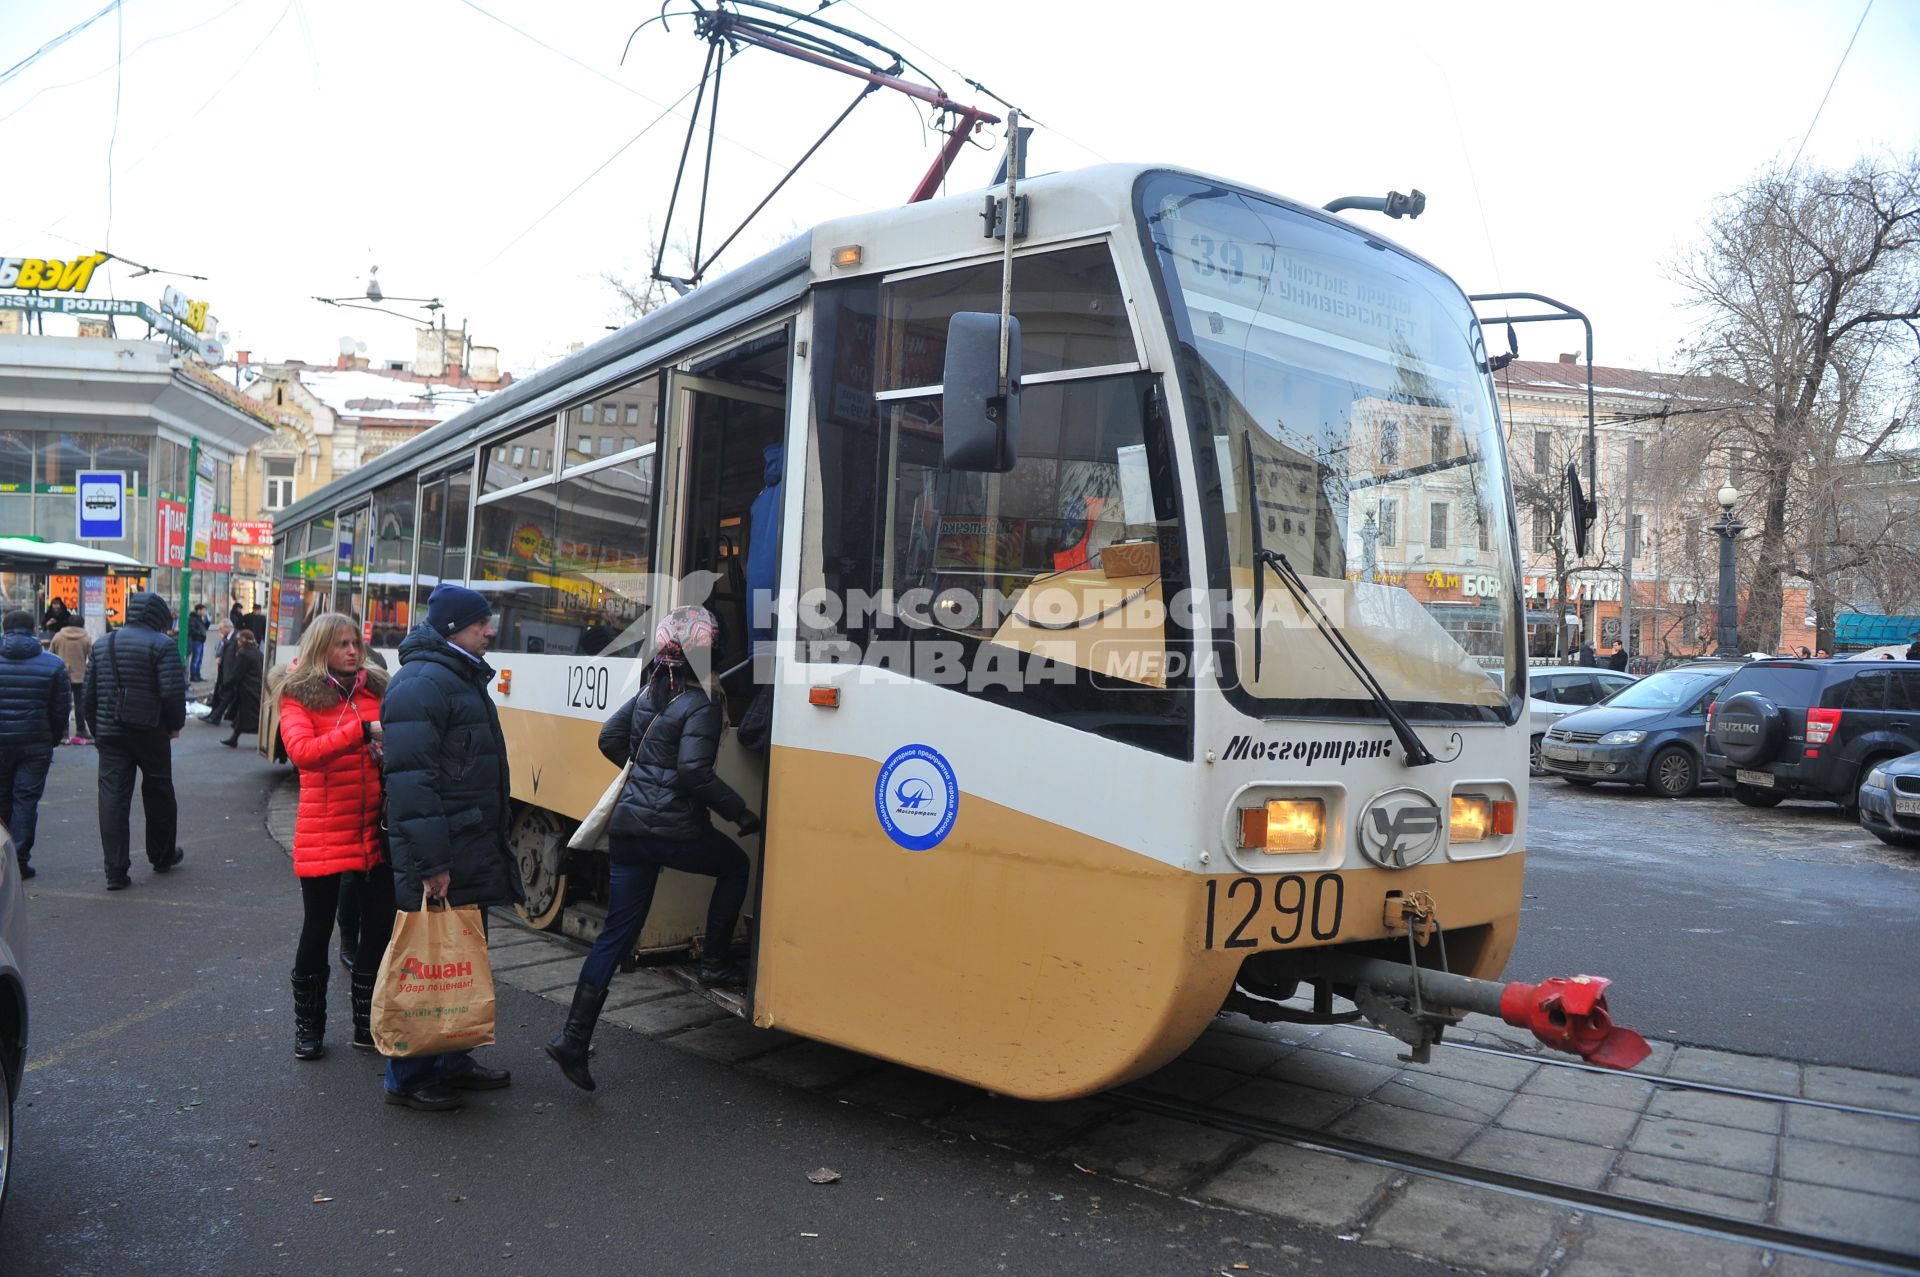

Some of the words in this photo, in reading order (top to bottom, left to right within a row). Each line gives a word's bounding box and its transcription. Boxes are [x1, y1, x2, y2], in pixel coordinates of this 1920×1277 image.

[1191, 233, 1243, 284] 39
[1283, 257, 1349, 295] ЧИСТЫЕ
[63, 298, 138, 312] роллы
[1280, 281, 1417, 336] УНИВЕРСИТЕТ
[1567, 579, 1620, 601] УТКИ
[567, 665, 609, 710] 1290
[1718, 722, 1760, 733] SUZUKI
[1222, 735, 1393, 766] Мосгортранс
[896, 808, 937, 817] Мосгортранс
[1205, 872, 1345, 950] 1290
[400, 957, 472, 980] Ашан
[399, 983, 425, 993] Удар
[428, 984, 438, 992] по
[440, 978, 474, 993] ценам!
